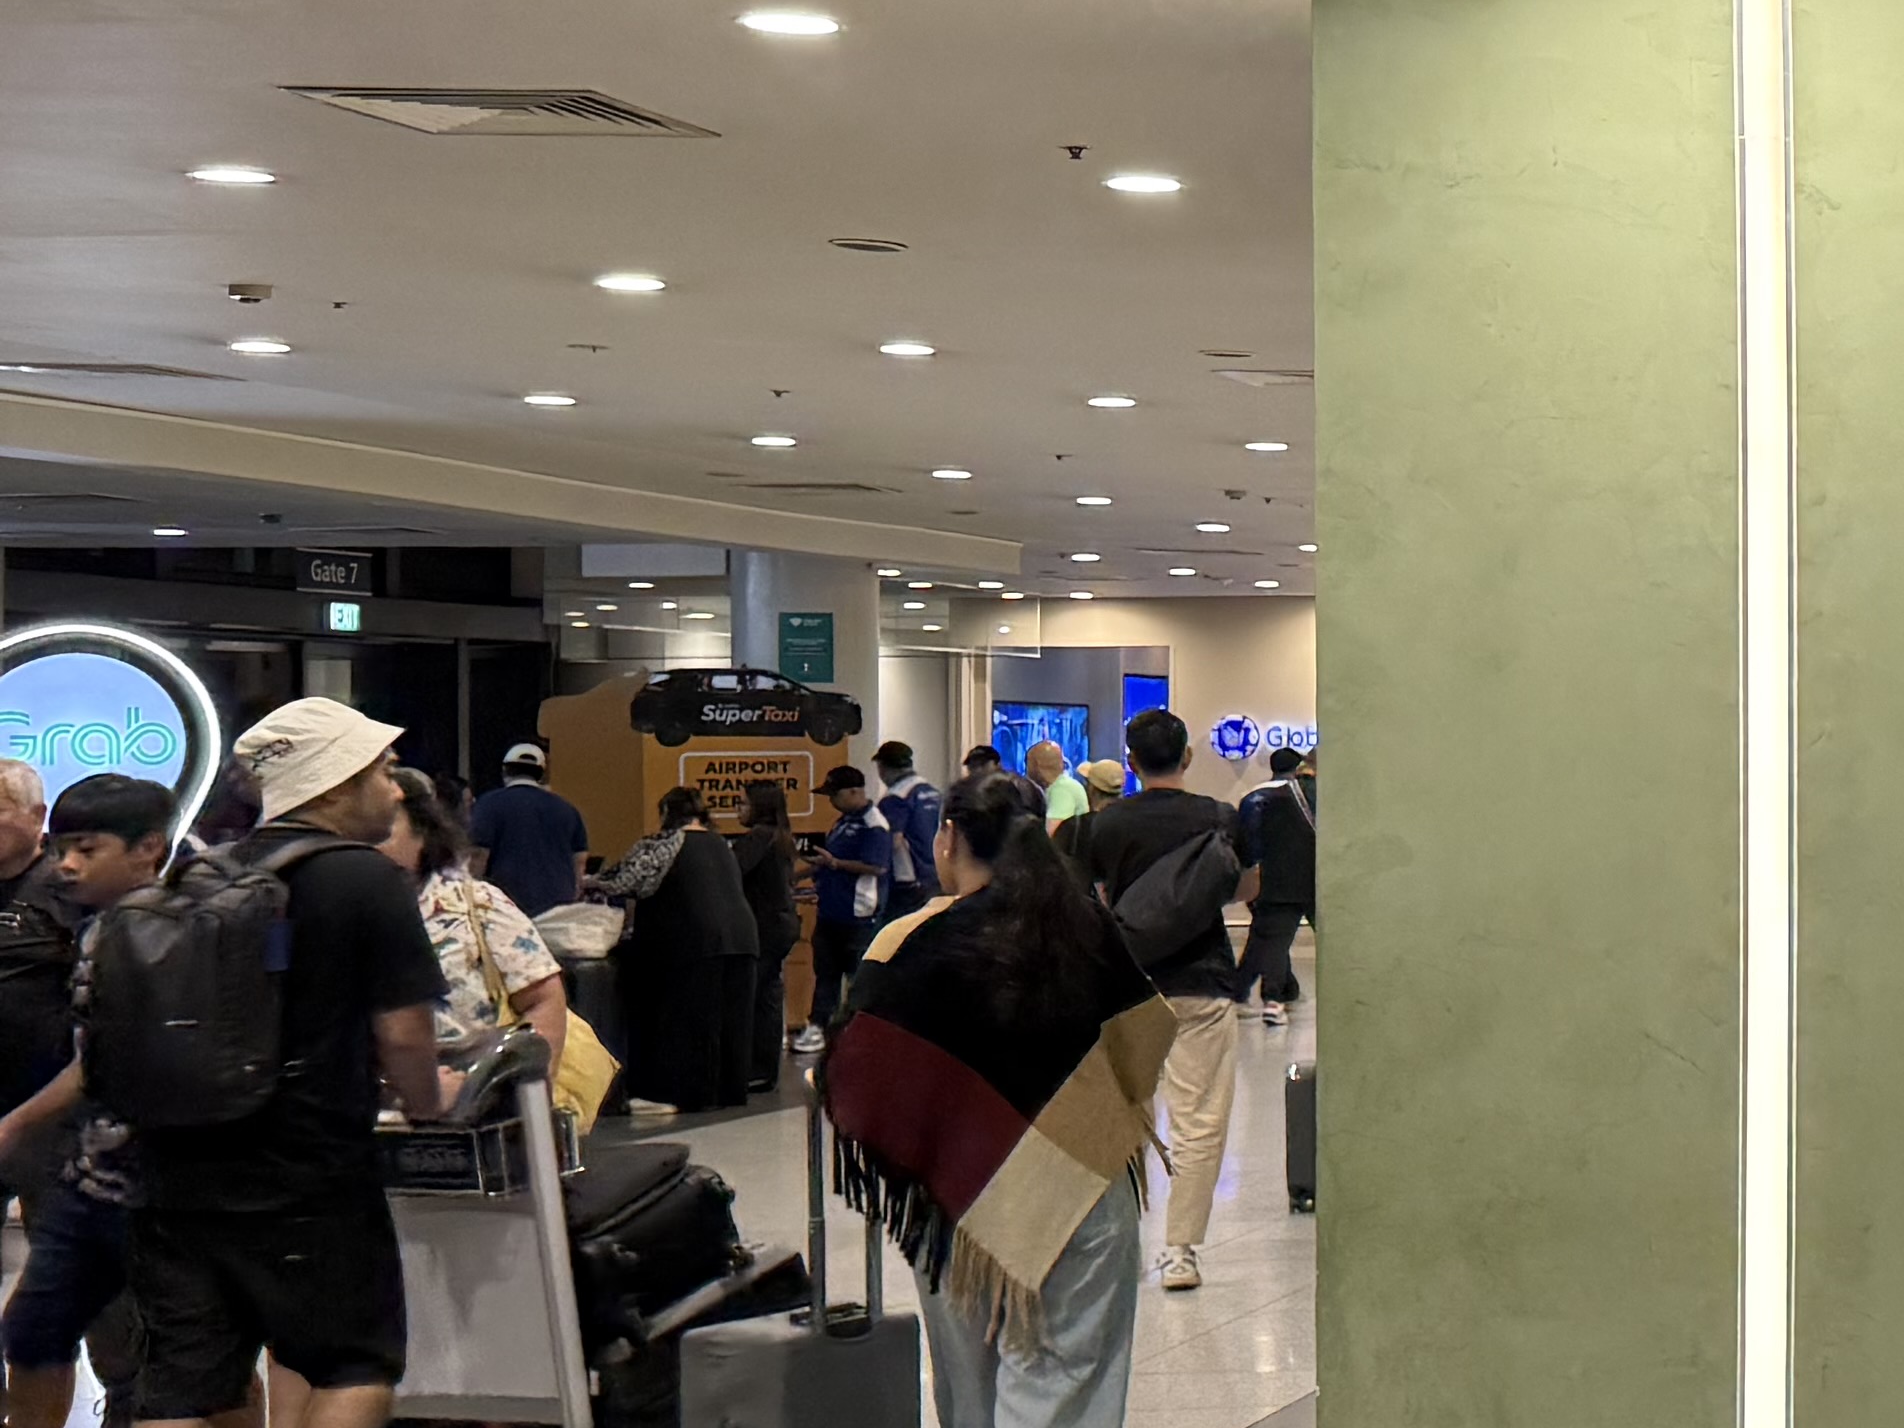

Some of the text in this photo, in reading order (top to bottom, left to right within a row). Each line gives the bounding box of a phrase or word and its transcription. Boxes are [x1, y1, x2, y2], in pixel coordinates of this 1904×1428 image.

[311, 559, 359, 584] Gate 7
[0, 707, 177, 766] Grab
[705, 760, 791, 775] AIRPORT
[696, 777, 798, 792] TRANR
